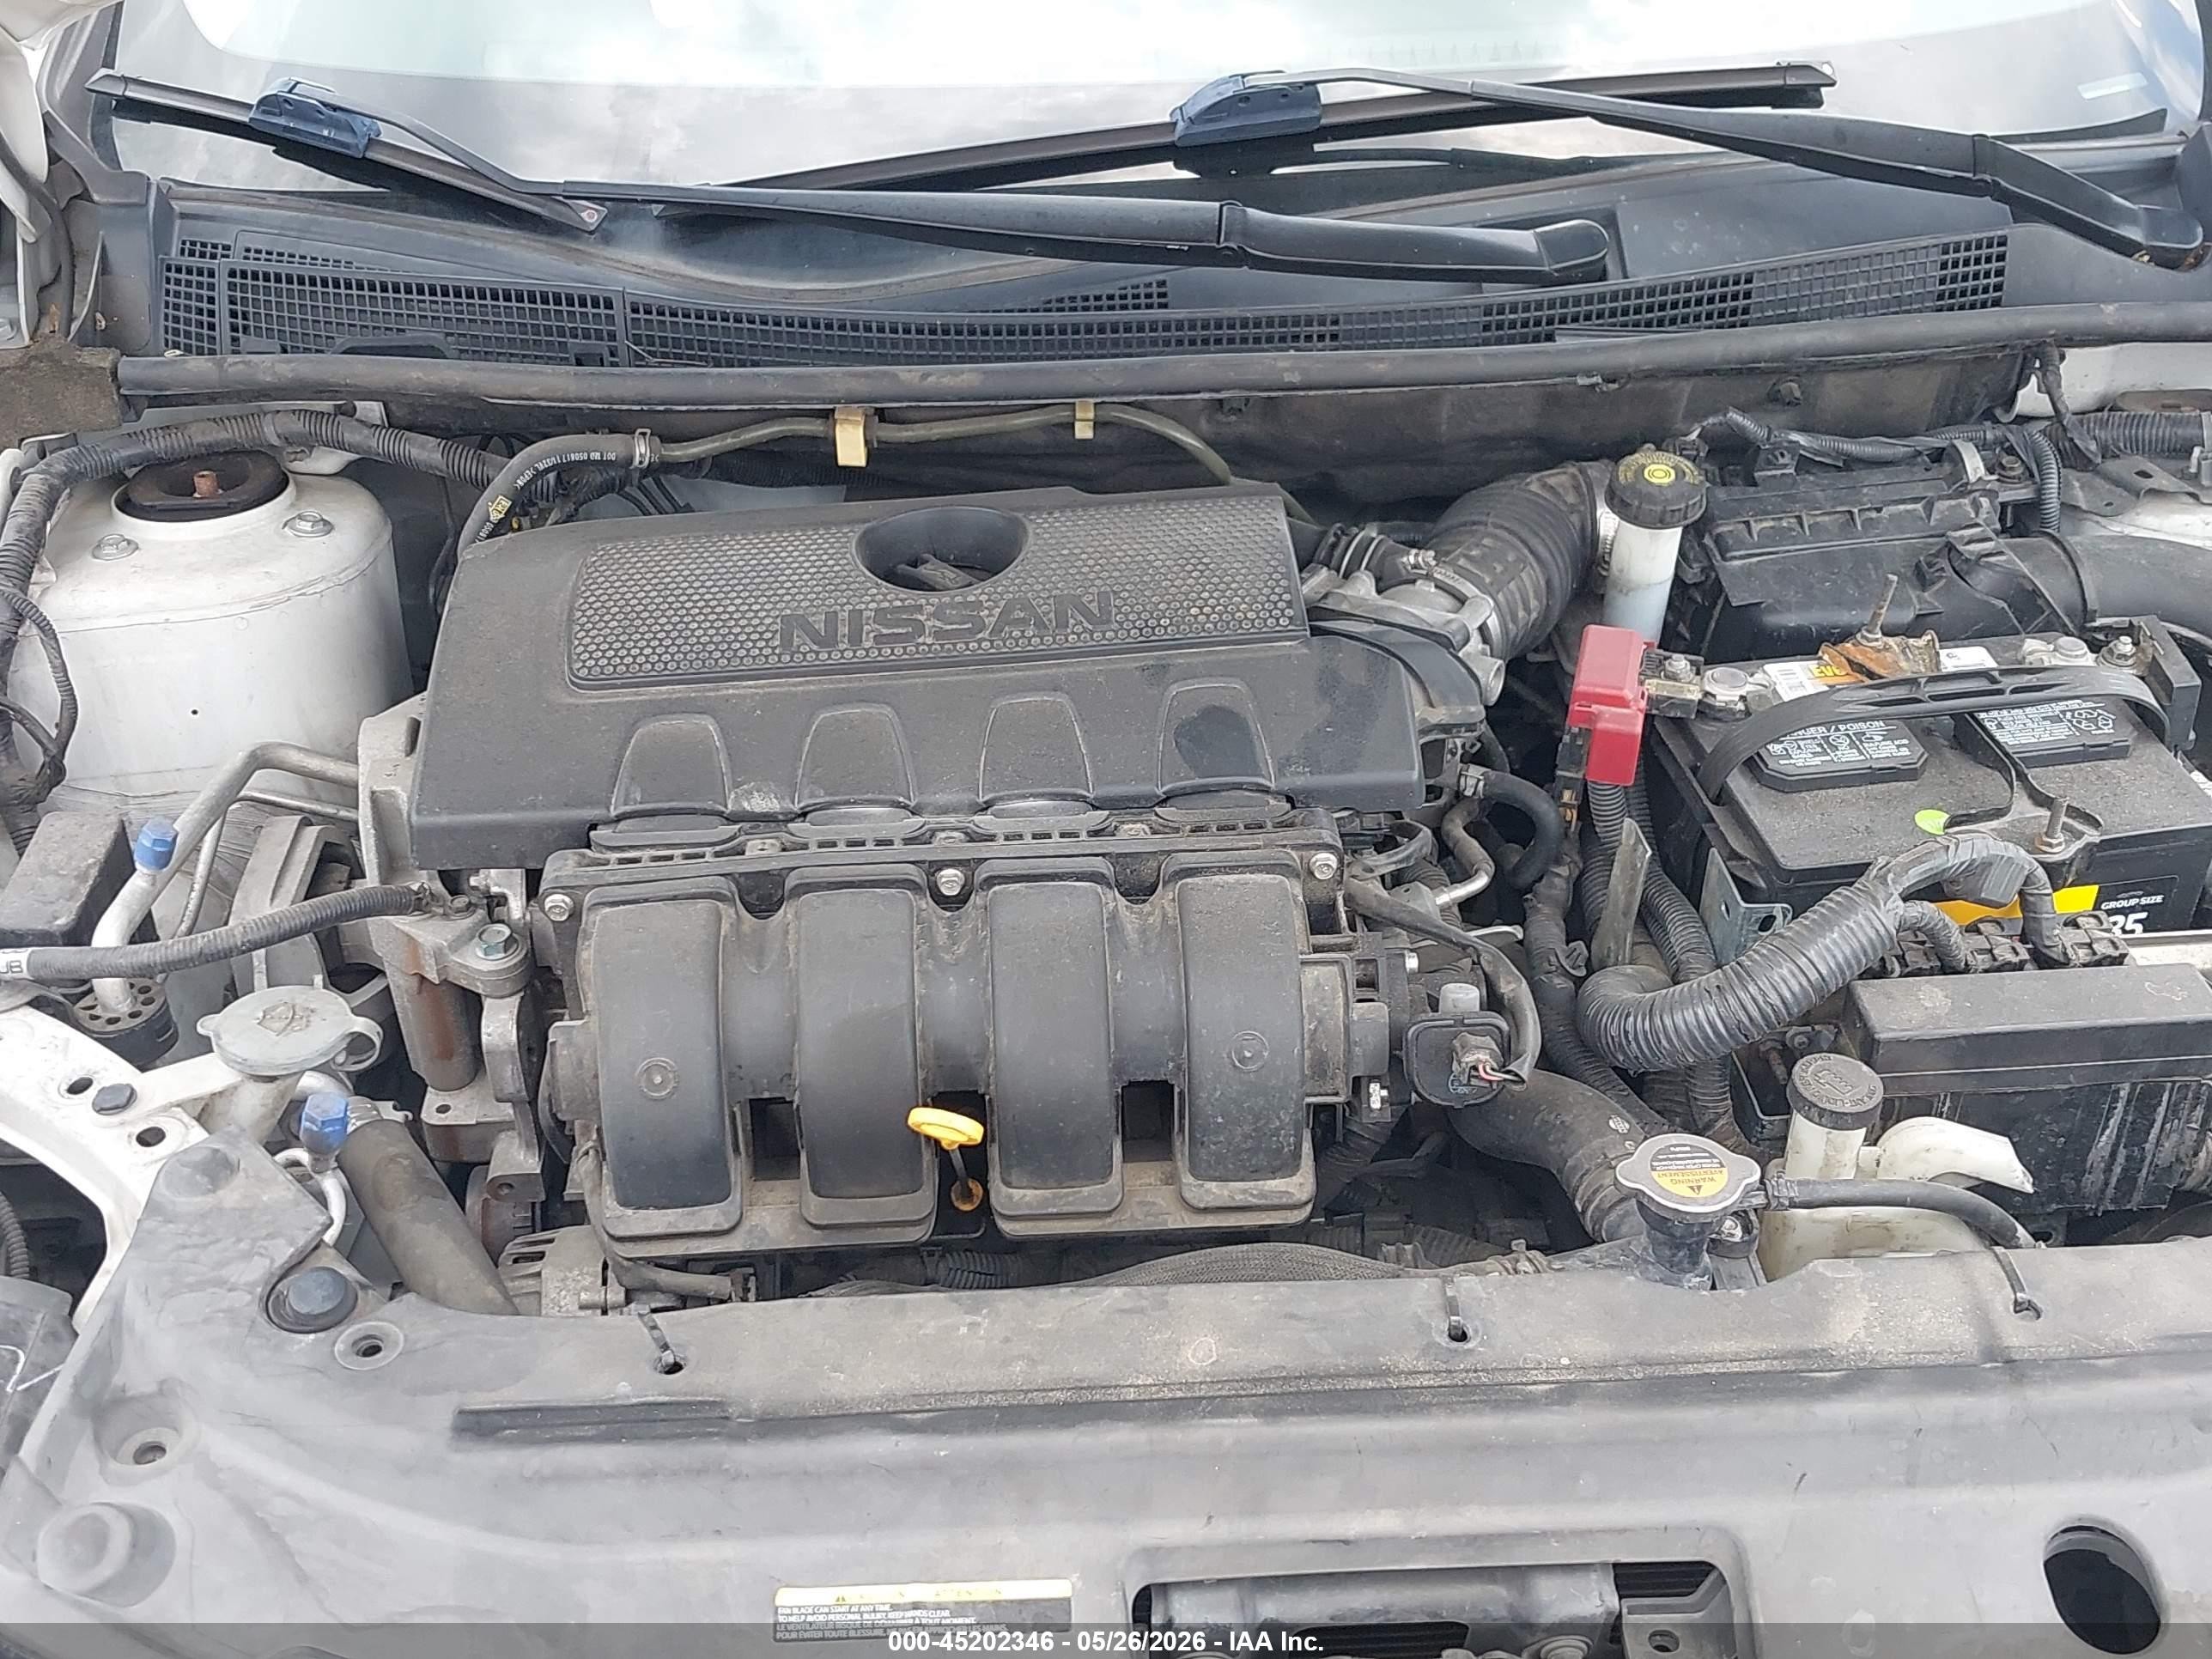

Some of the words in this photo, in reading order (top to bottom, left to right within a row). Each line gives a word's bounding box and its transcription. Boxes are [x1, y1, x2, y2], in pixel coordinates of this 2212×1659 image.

[779, 591, 1115, 653] NISSAN
[1838, 720, 1886, 731] POISON
[2100, 898, 2140, 909] GROUP
[2139, 895, 2165, 905] SIZE
